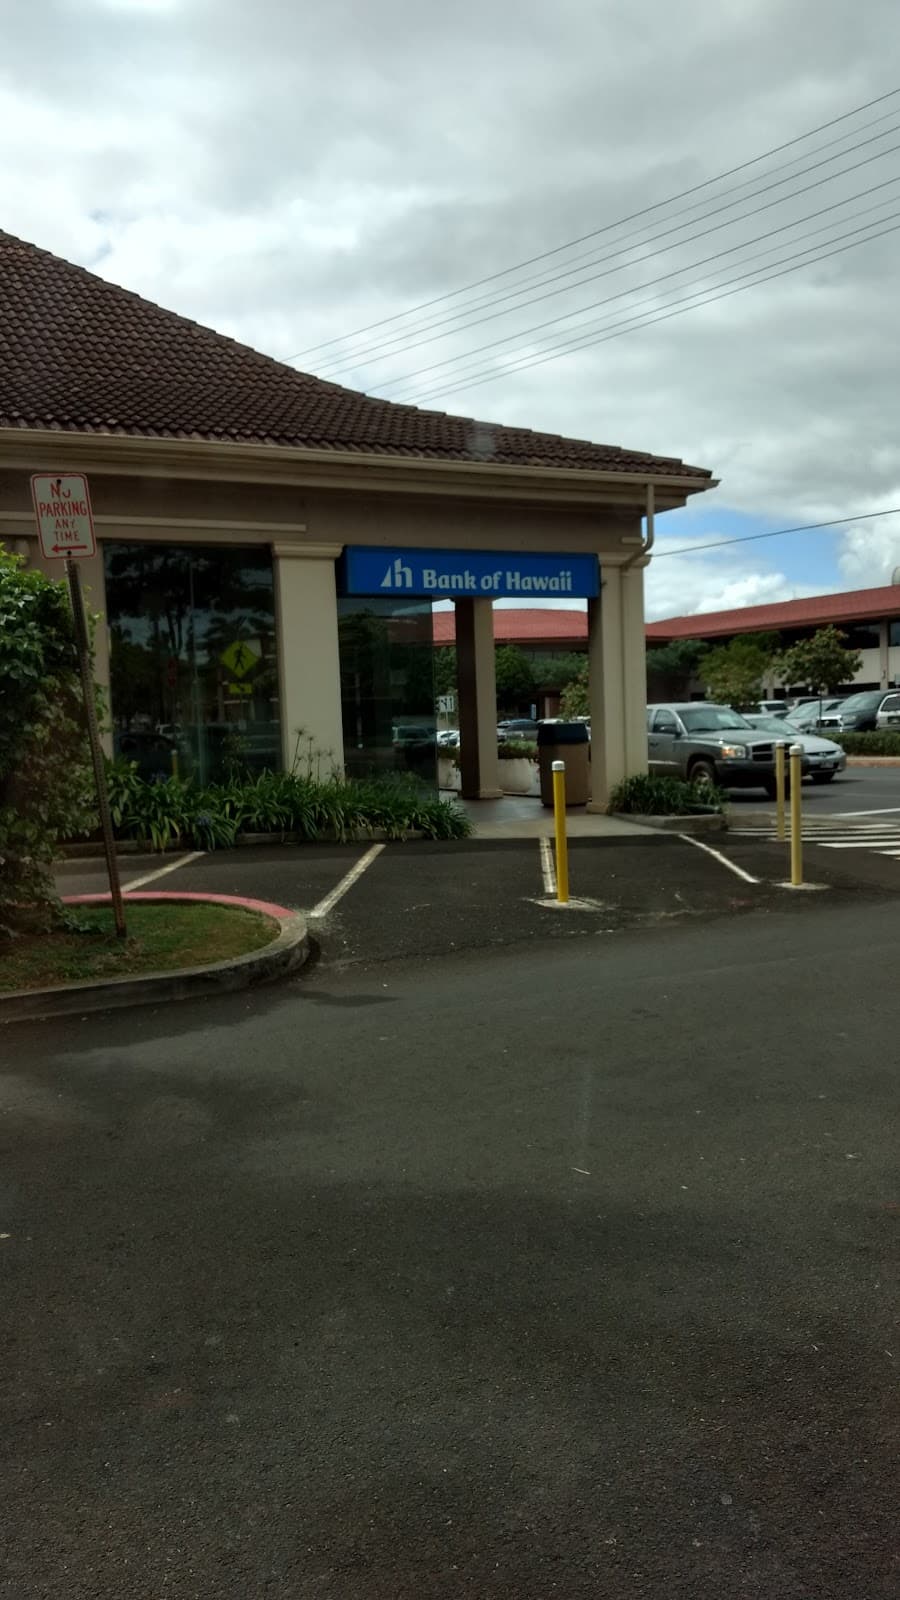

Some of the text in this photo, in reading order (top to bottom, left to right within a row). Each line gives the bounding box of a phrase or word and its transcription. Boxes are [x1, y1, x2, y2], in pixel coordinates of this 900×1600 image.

[39, 501, 87, 517] PARKING
[55, 519, 75, 529] ANY
[54, 531, 80, 542] TIME
[422, 569, 573, 592] Bank of Hawaii
